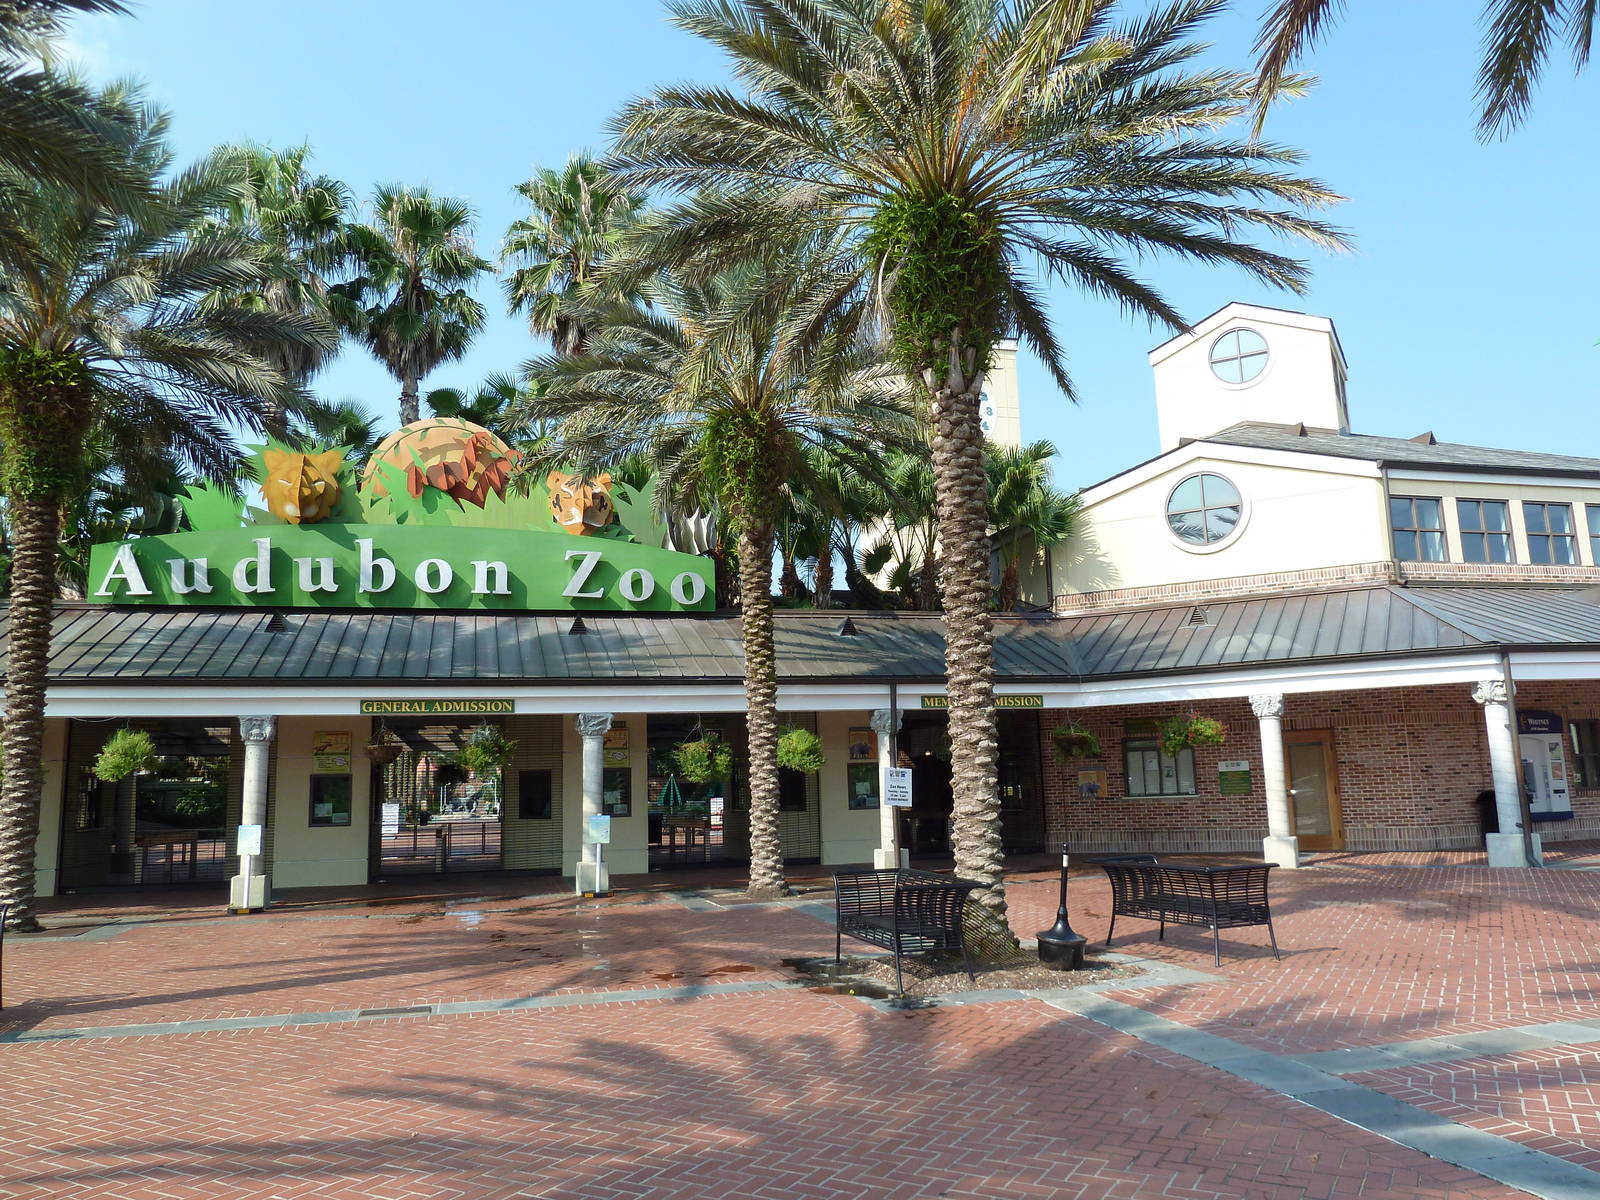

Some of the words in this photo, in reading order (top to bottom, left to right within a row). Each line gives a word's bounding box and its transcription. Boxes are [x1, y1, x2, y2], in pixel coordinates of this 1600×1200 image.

[94, 537, 512, 596] Audubon
[562, 550, 706, 605] Zoo
[362, 701, 429, 713] GENERAL
[432, 701, 513, 713] ADMISSION
[924, 697, 951, 707] MEM
[993, 696, 1042, 706] MISSION
